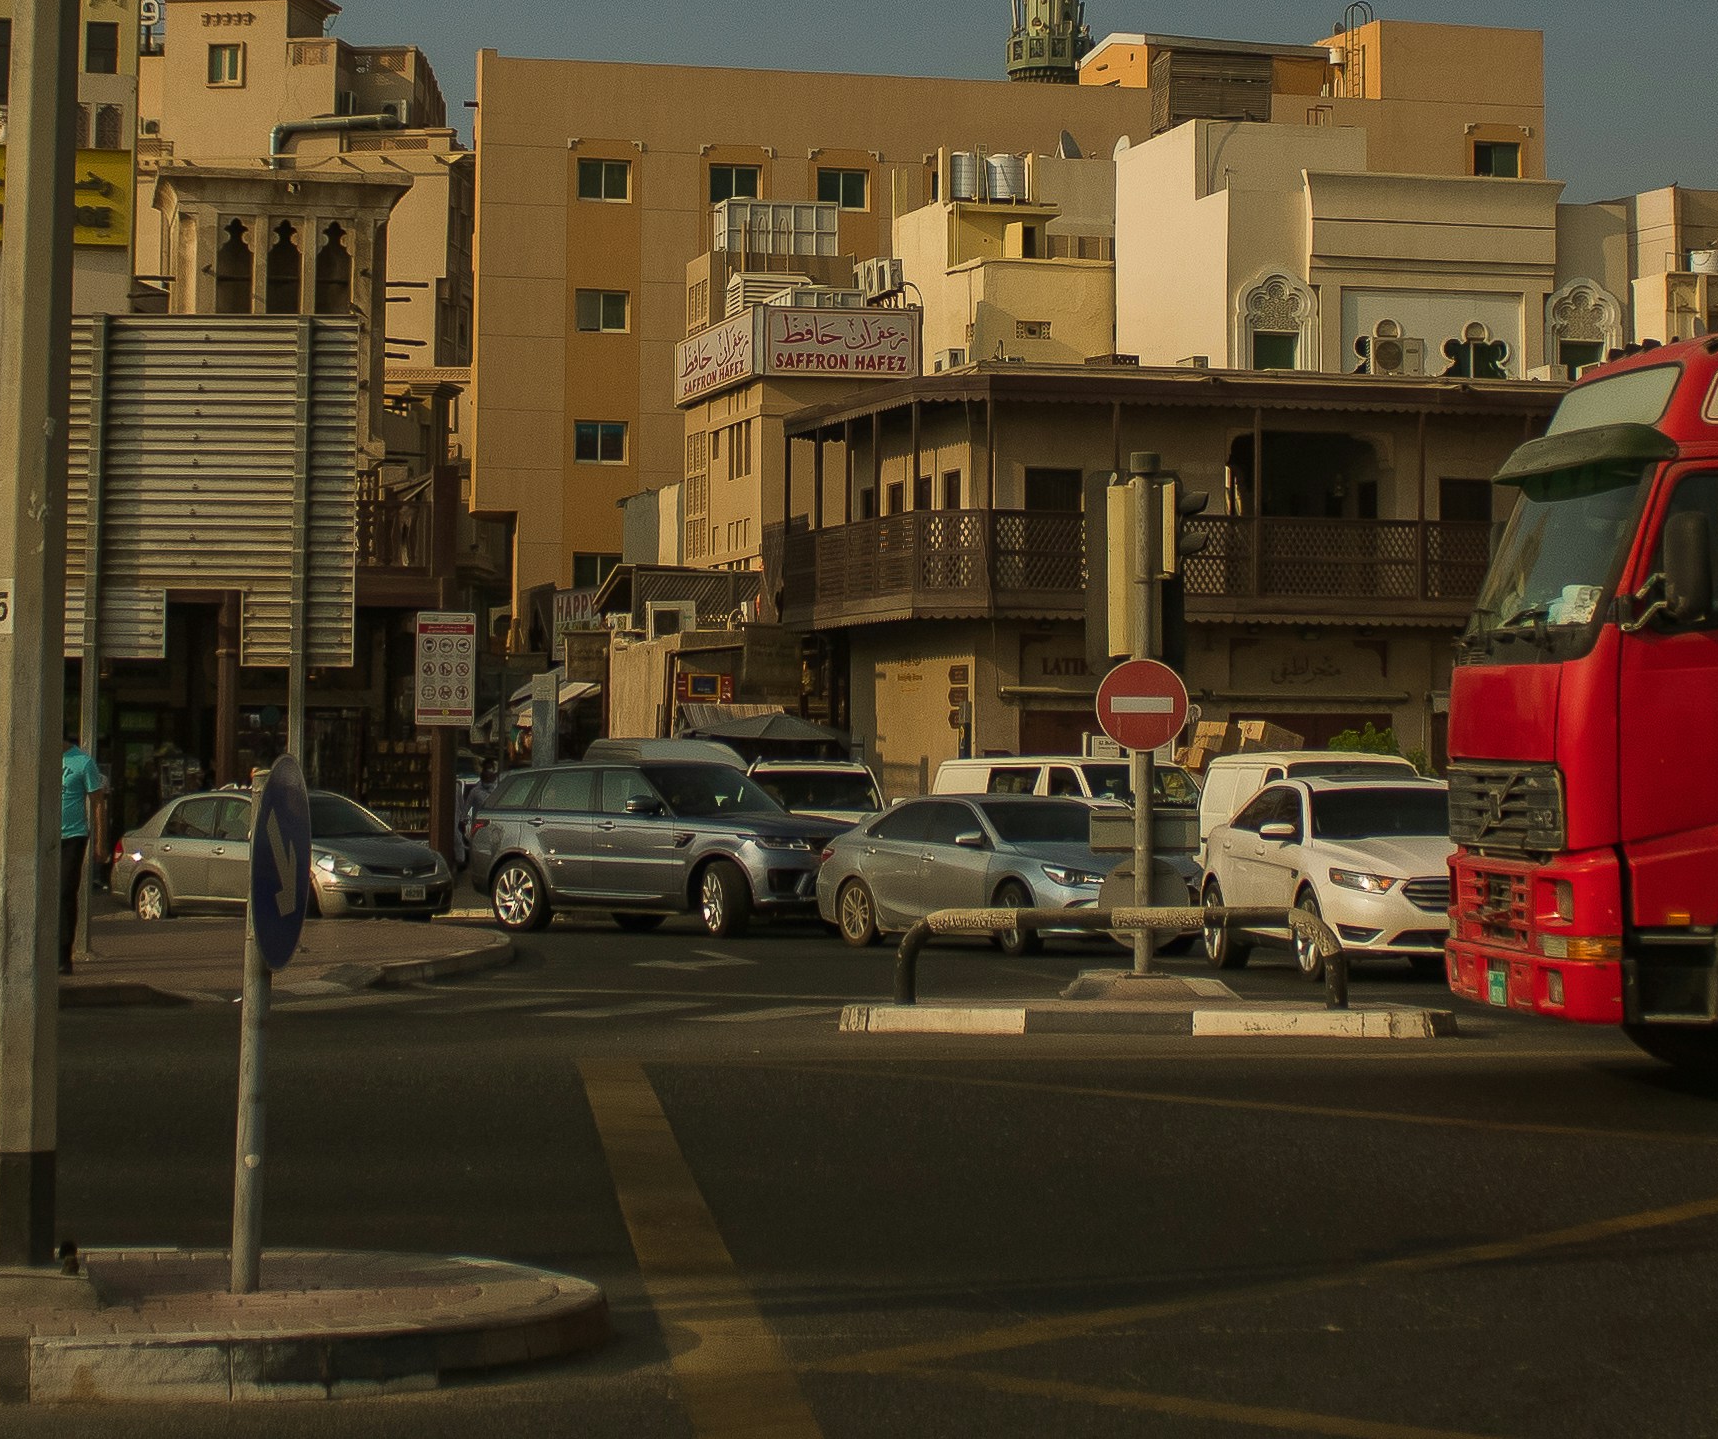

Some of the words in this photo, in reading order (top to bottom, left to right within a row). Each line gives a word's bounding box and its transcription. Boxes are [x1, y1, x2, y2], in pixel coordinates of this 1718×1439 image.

[774, 313, 844, 346] حافظ
[844, 318, 910, 351] زعفران
[679, 339, 713, 378] حافظ
[715, 325, 749, 368] زعفران
[775, 351, 850, 371] SAFFRON
[854, 353, 907, 372] HAFEZ
[683, 368, 718, 396] SAFFRON
[718, 359, 745, 383] HAFEZ
[556, 593, 598, 623] HAPPY
